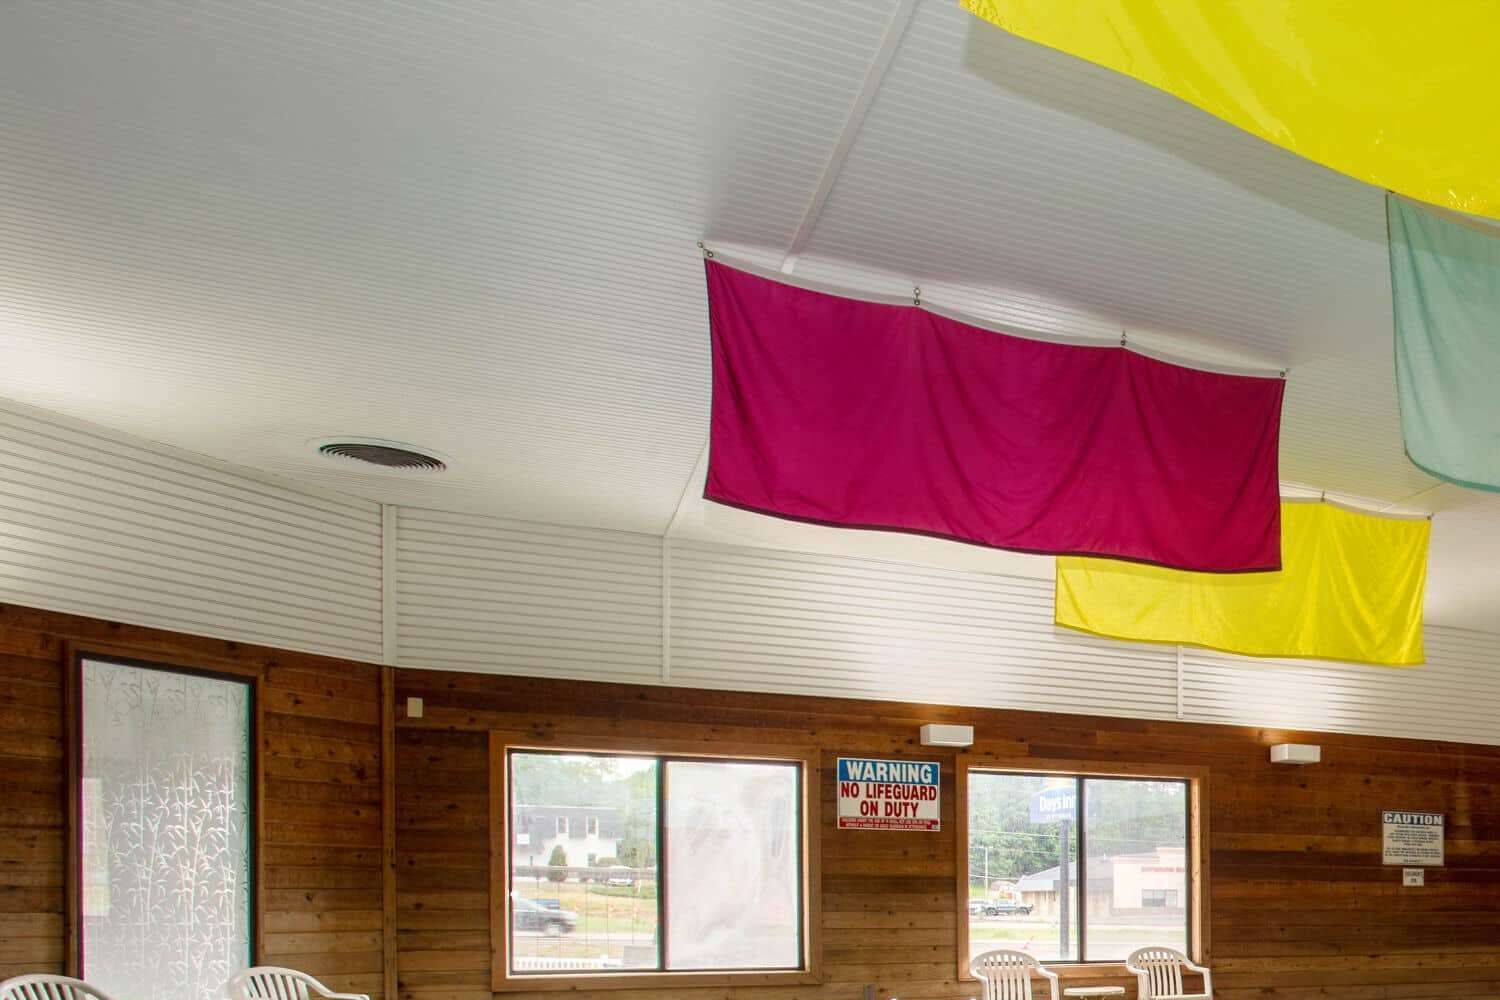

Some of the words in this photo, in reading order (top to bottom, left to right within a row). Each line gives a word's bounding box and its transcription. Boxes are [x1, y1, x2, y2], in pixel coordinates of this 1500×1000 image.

[846, 760, 932, 784] WARNING
[841, 782, 859, 798] NO
[866, 783, 937, 801] LIFEGUARD
[860, 800, 878, 816] ON
[885, 801, 919, 817] DUTY
[1384, 813, 1442, 825] CAUTION
